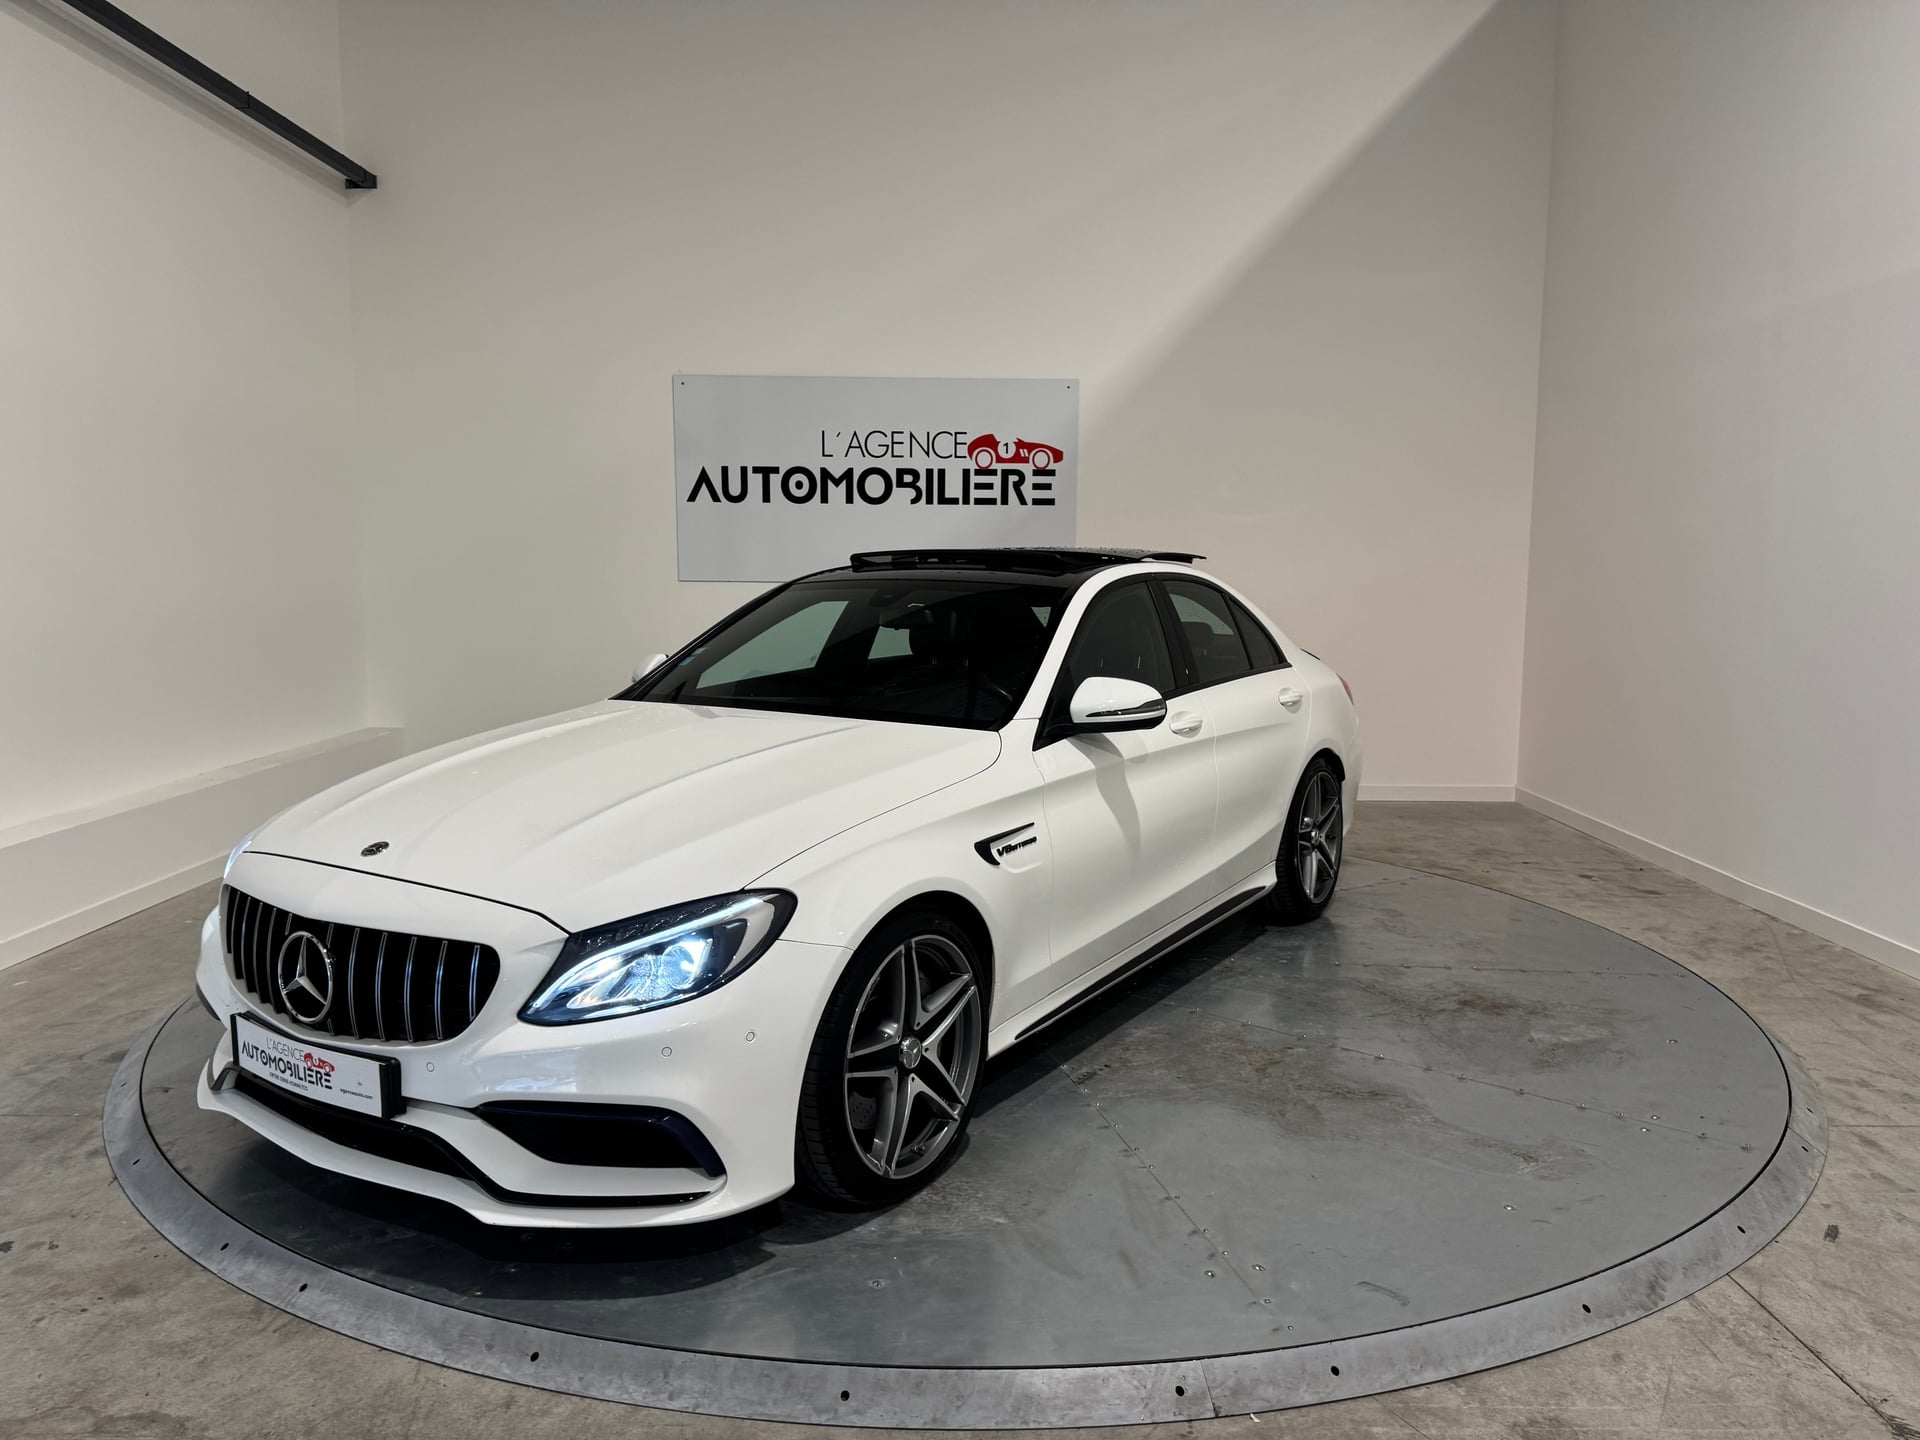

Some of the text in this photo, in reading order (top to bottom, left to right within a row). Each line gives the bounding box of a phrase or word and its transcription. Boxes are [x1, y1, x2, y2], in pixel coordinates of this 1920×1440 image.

[1003, 442, 1009, 454] 1
[686, 466, 1056, 506] AUTOMOBILIERE
[242, 1040, 332, 1090] AUTOMOBILIERE
